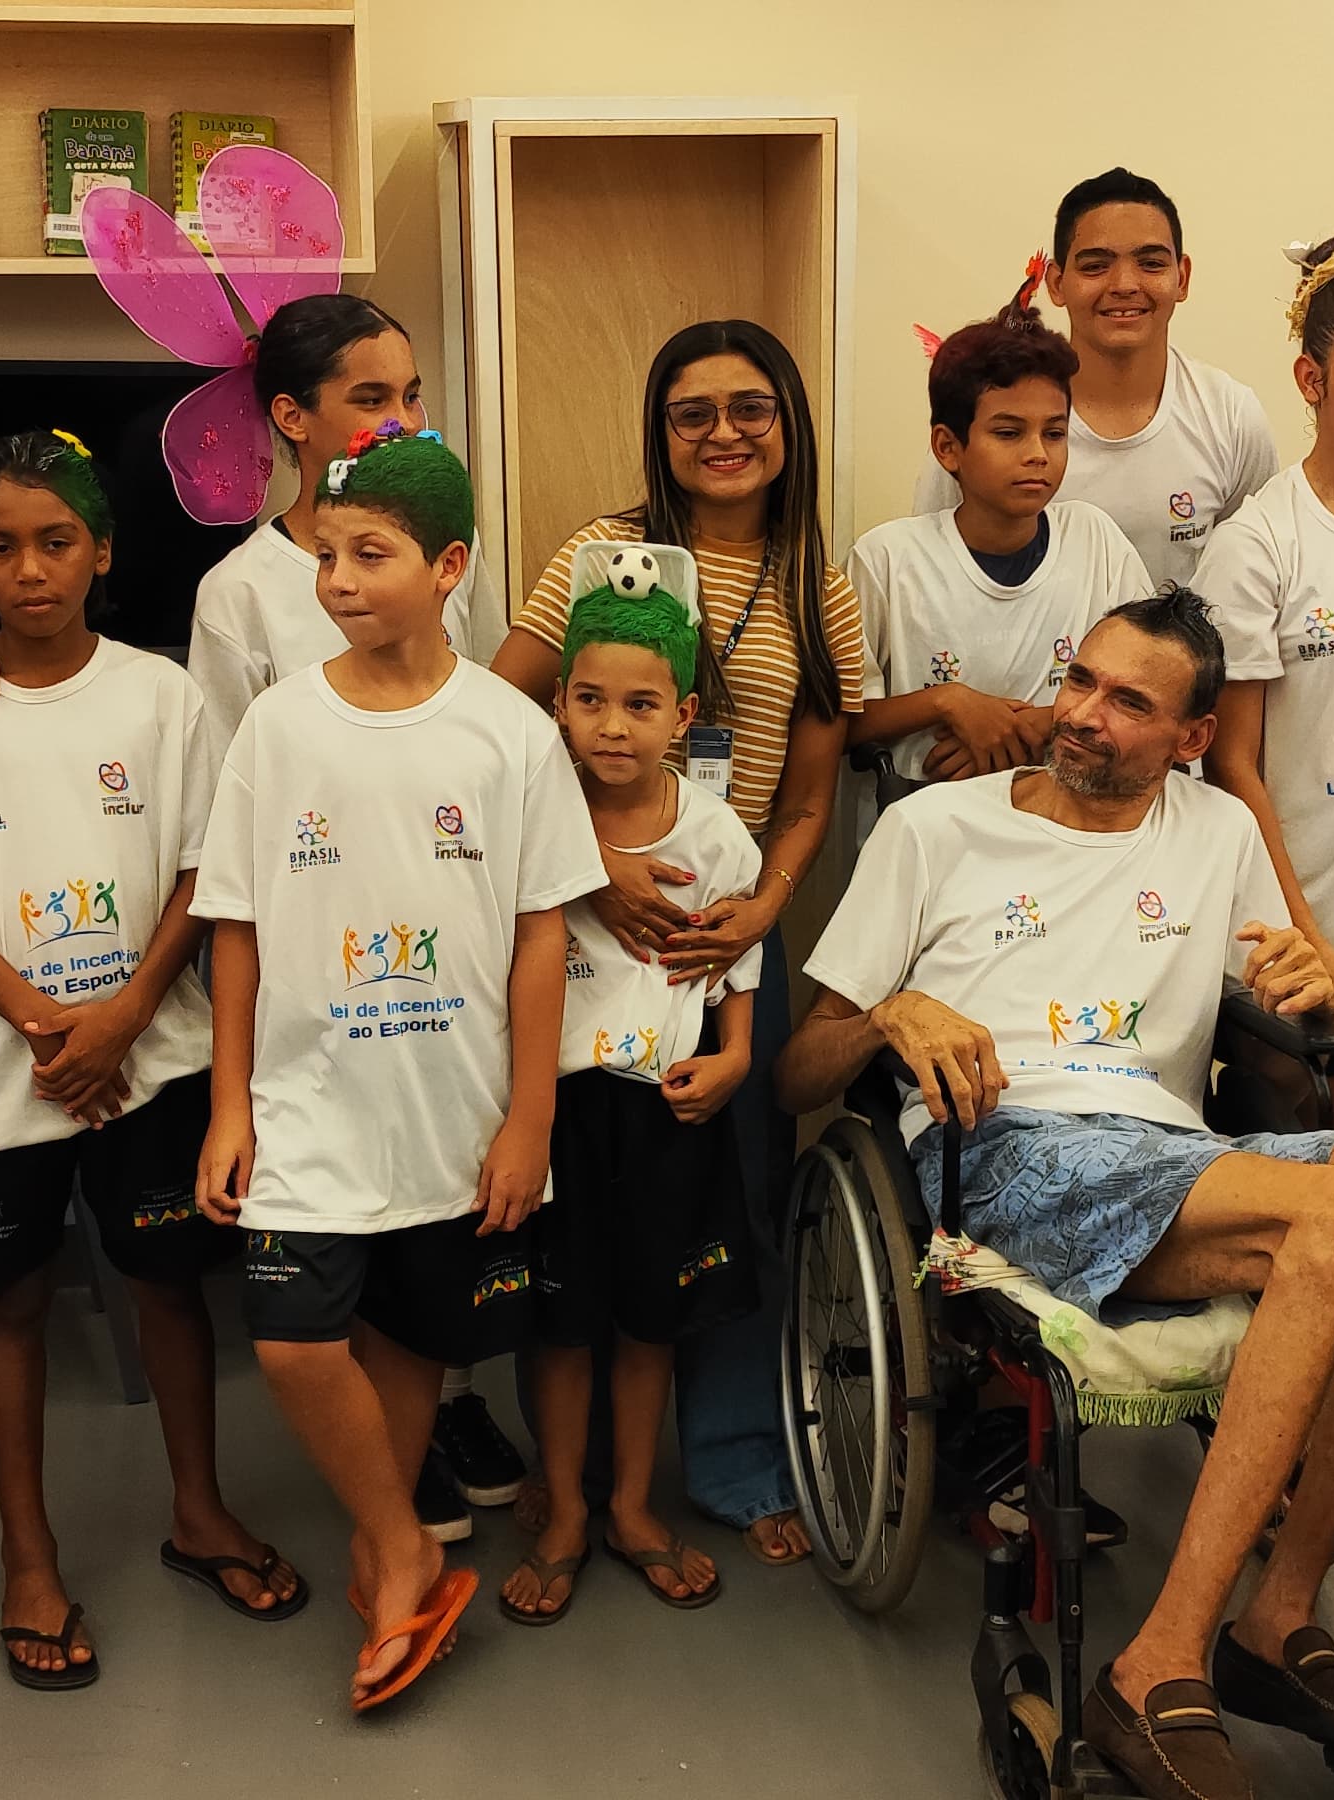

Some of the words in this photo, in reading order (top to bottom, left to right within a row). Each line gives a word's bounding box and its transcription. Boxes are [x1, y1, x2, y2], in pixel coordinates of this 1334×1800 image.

[71, 116, 129, 129] DIÁRIO
[64, 138, 136, 161] Banana
[289, 846, 341, 863] BRASIL
[1139, 922, 1192, 944] incluir
[40, 962, 64, 976] de
[356, 1003, 380, 1018] de
[386, 996, 465, 1015] Incentivo
[348, 1026, 373, 1039] ao
[379, 1018, 450, 1038] Esporte
